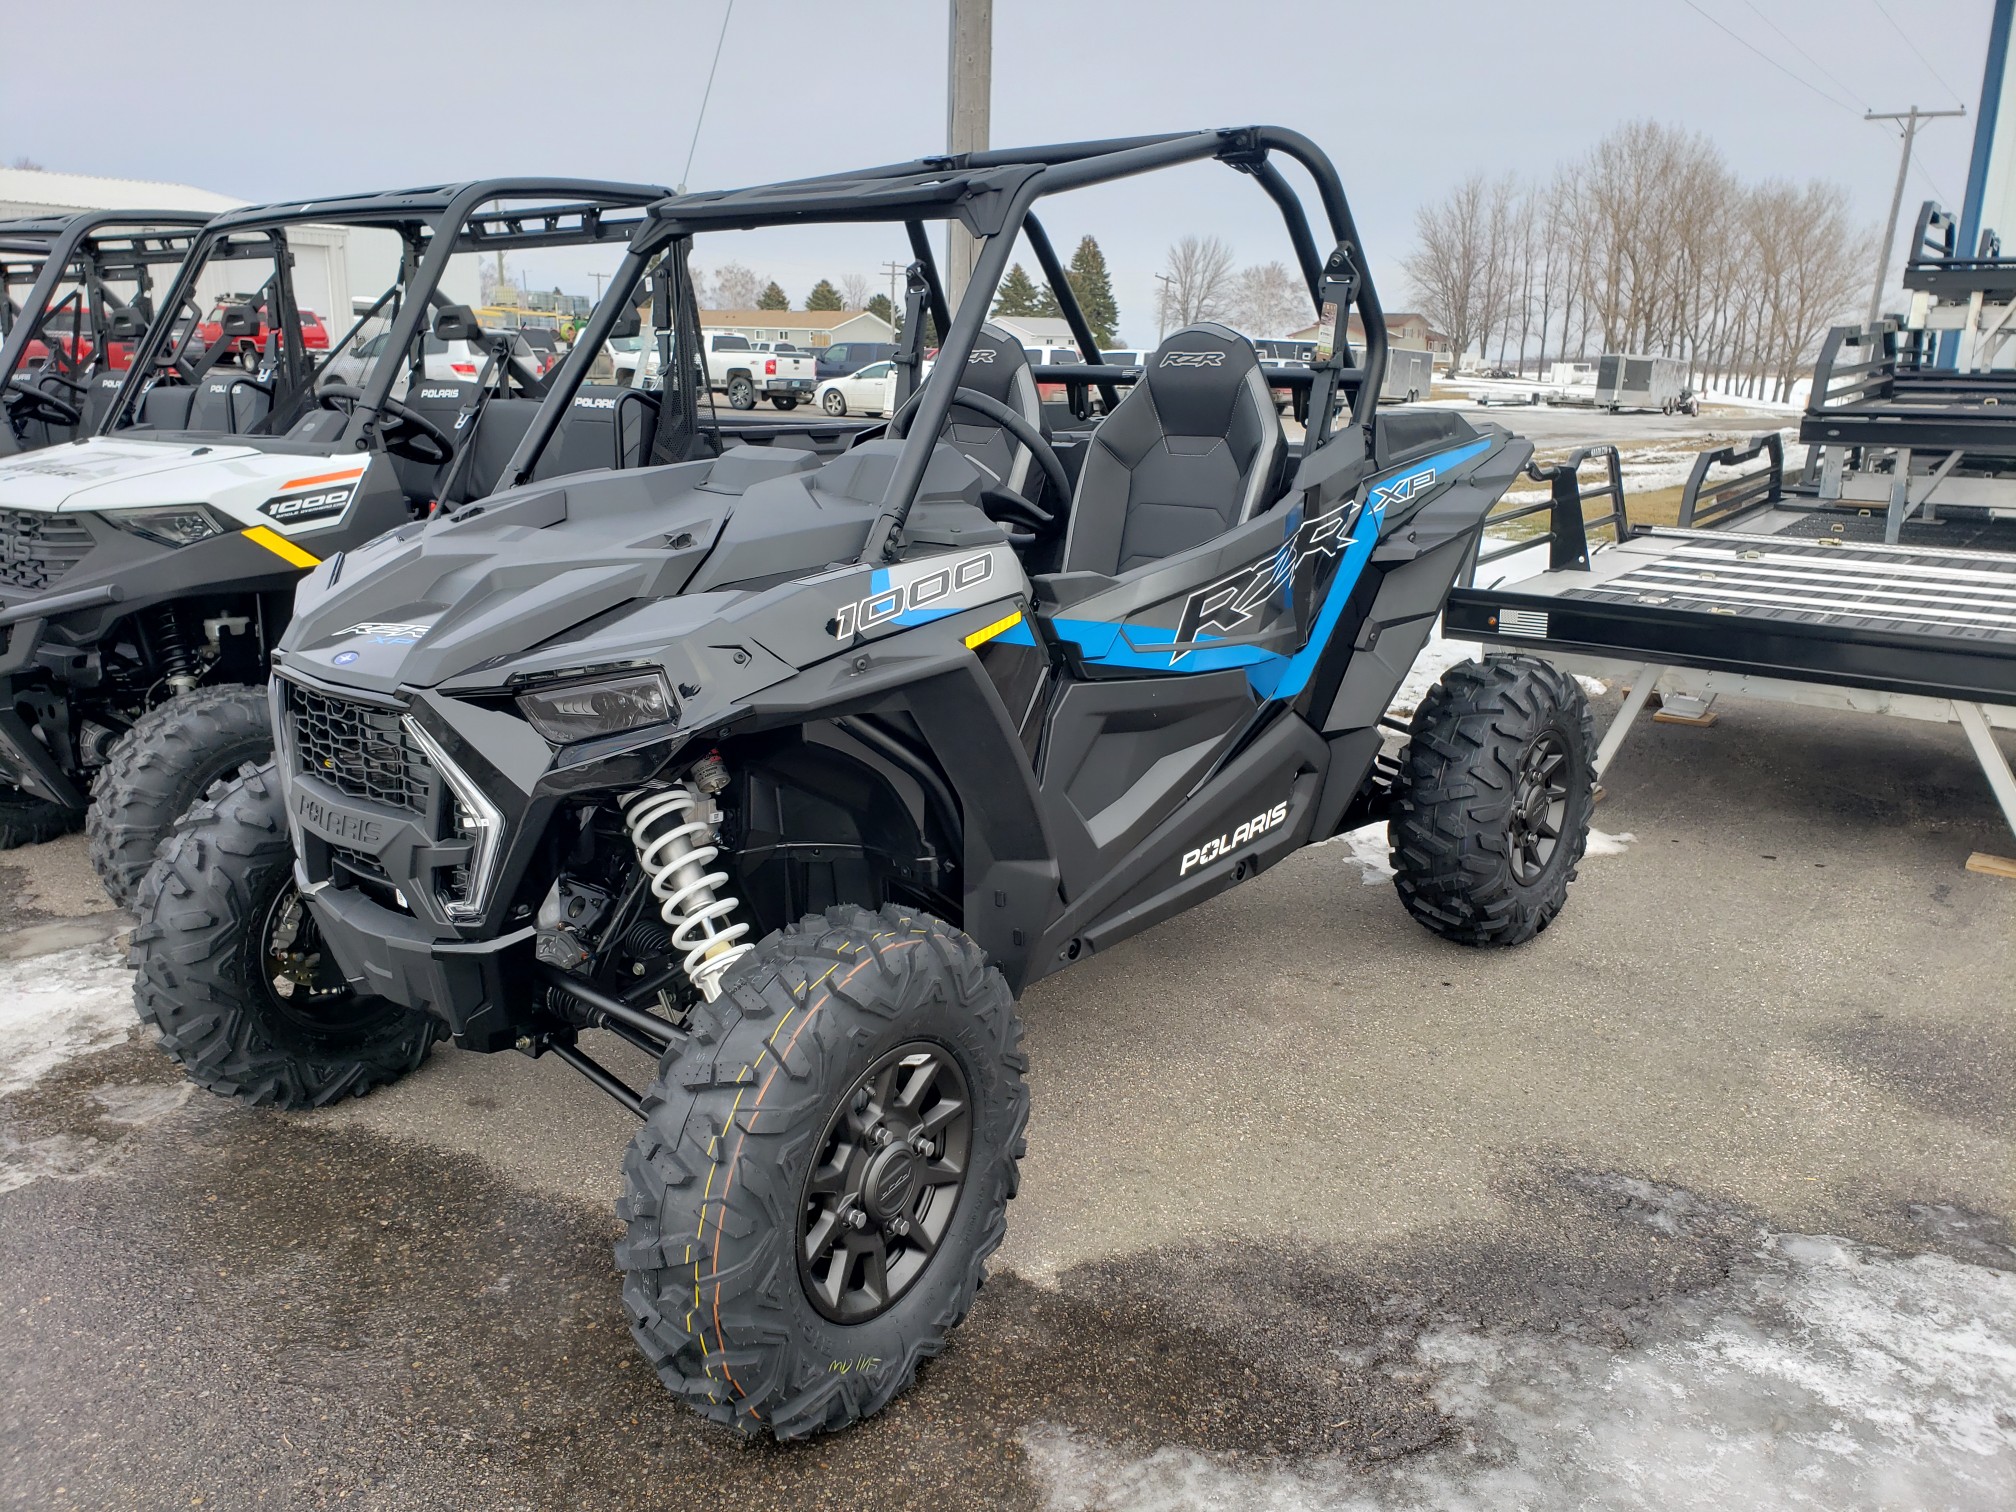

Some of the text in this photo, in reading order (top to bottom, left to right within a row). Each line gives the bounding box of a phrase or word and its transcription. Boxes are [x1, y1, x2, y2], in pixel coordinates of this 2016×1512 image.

[968, 349, 997, 364] ZR
[1159, 351, 1226, 368] RZR
[421, 389, 459, 399] POLARIS
[269, 491, 349, 516] 1000
[1367, 468, 1436, 515] XP
[836, 551, 994, 640] 1000
[1169, 500, 1361, 666] RZR
[300, 795, 382, 845] POLARIS
[1180, 801, 1287, 876] POLARIS
